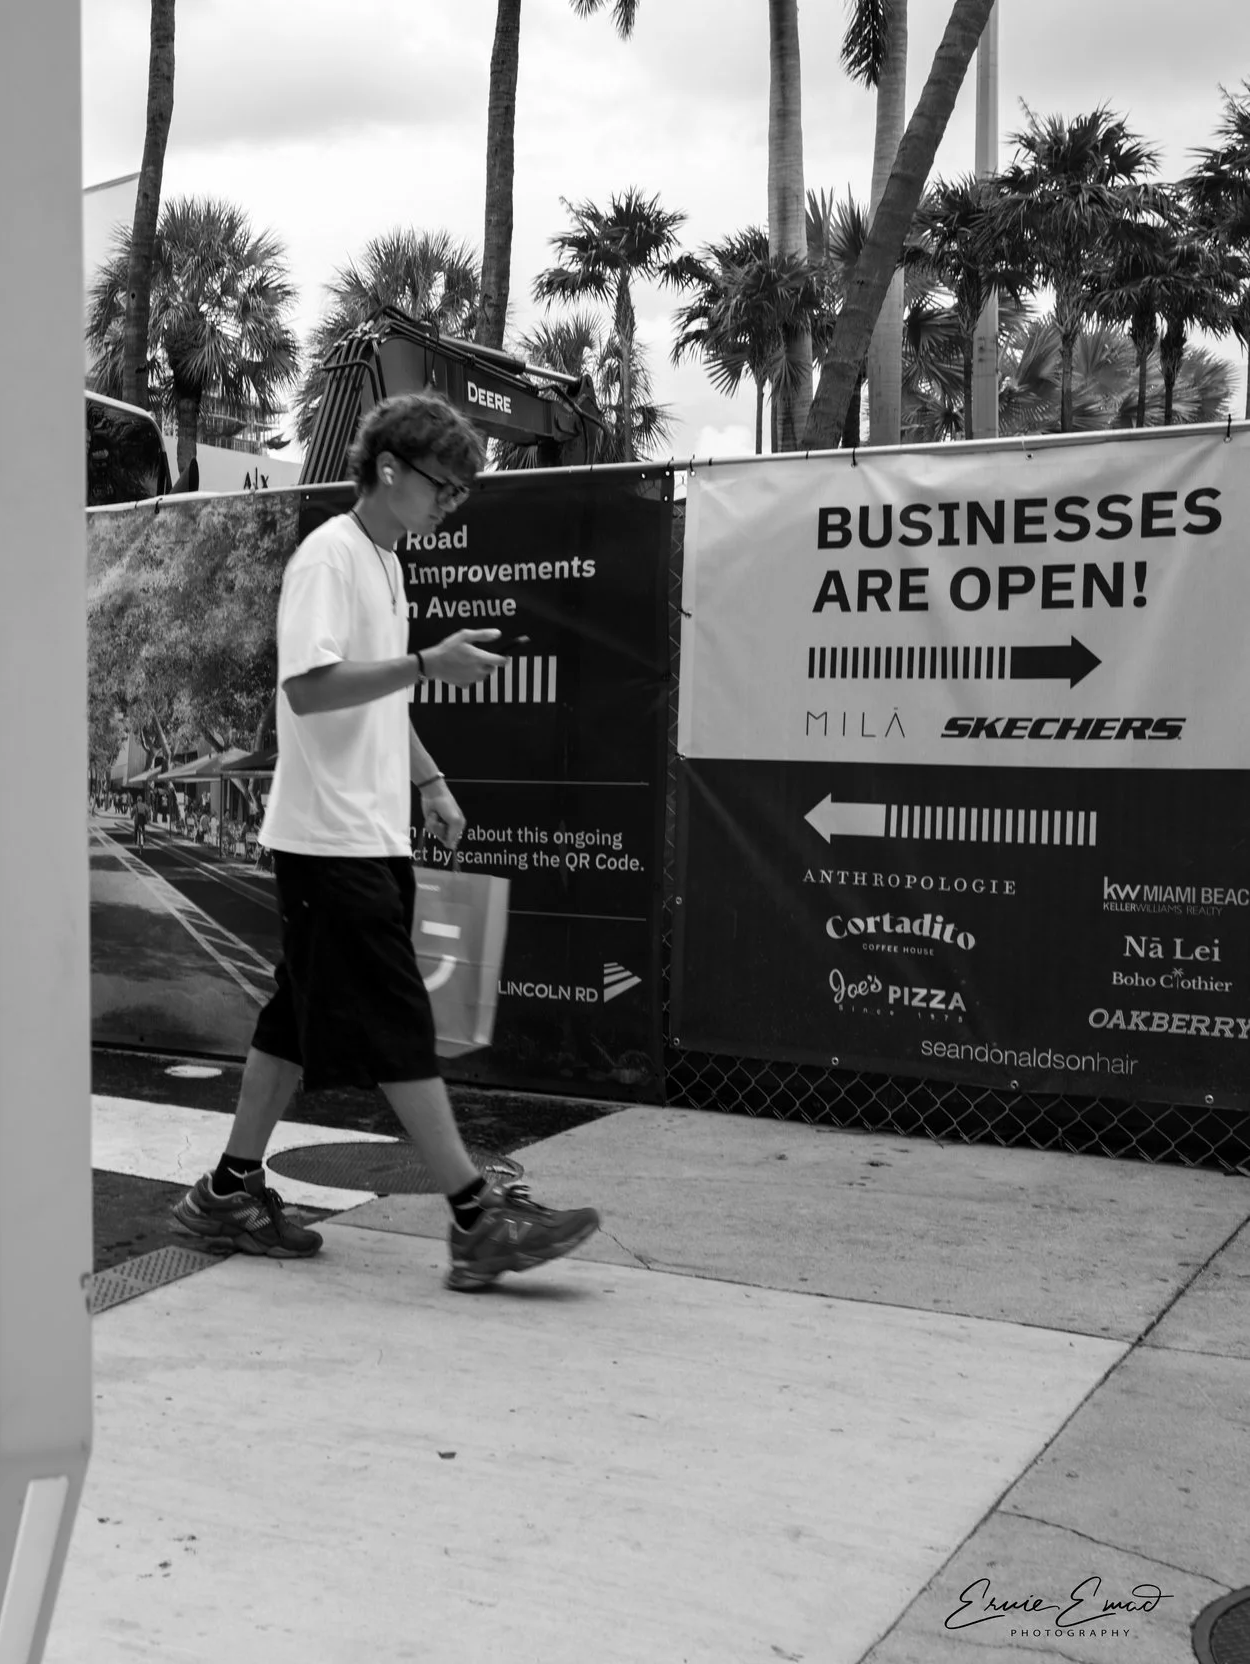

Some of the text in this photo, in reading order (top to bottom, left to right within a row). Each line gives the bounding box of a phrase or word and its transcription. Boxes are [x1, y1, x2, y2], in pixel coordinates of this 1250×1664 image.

[466, 380, 512, 414] DEERE
[817, 487, 1222, 550] BUSINESSES
[406, 524, 468, 551] Road
[407, 556, 596, 589] Improvements
[812, 560, 1147, 613] ARE OPEN!
[425, 596, 517, 619] Avenue
[940, 716, 1187, 740] SKECHERS
[467, 825, 513, 843] about
[517, 826, 548, 844] this
[553, 829, 623, 850] ongoing
[433, 846, 452, 866] by
[456, 849, 528, 871] scanning
[532, 851, 560, 868] the
[565, 852, 590, 872] QR
[595, 853, 645, 872] Code.
[802, 868, 1017, 896] ANTHROPOLOGIE
[1103, 876, 1141, 901] kw
[1143, 885, 1196, 904] MIAMI
[1186, 905, 1224, 917] REALTY
[825, 912, 976, 951] Cortadito
[862, 943, 935, 957] COFFEE HOUSE
[1173, 938, 1222, 962] Lei
[498, 980, 599, 1003] LINCOLN RD
[828, 968, 966, 1013] Joe's PIZZA
[1112, 971, 1156, 988] Boho
[1088, 1007, 1250, 1040] OAKBERRY
[921, 1040, 1138, 1075] seandonaldsonhair
